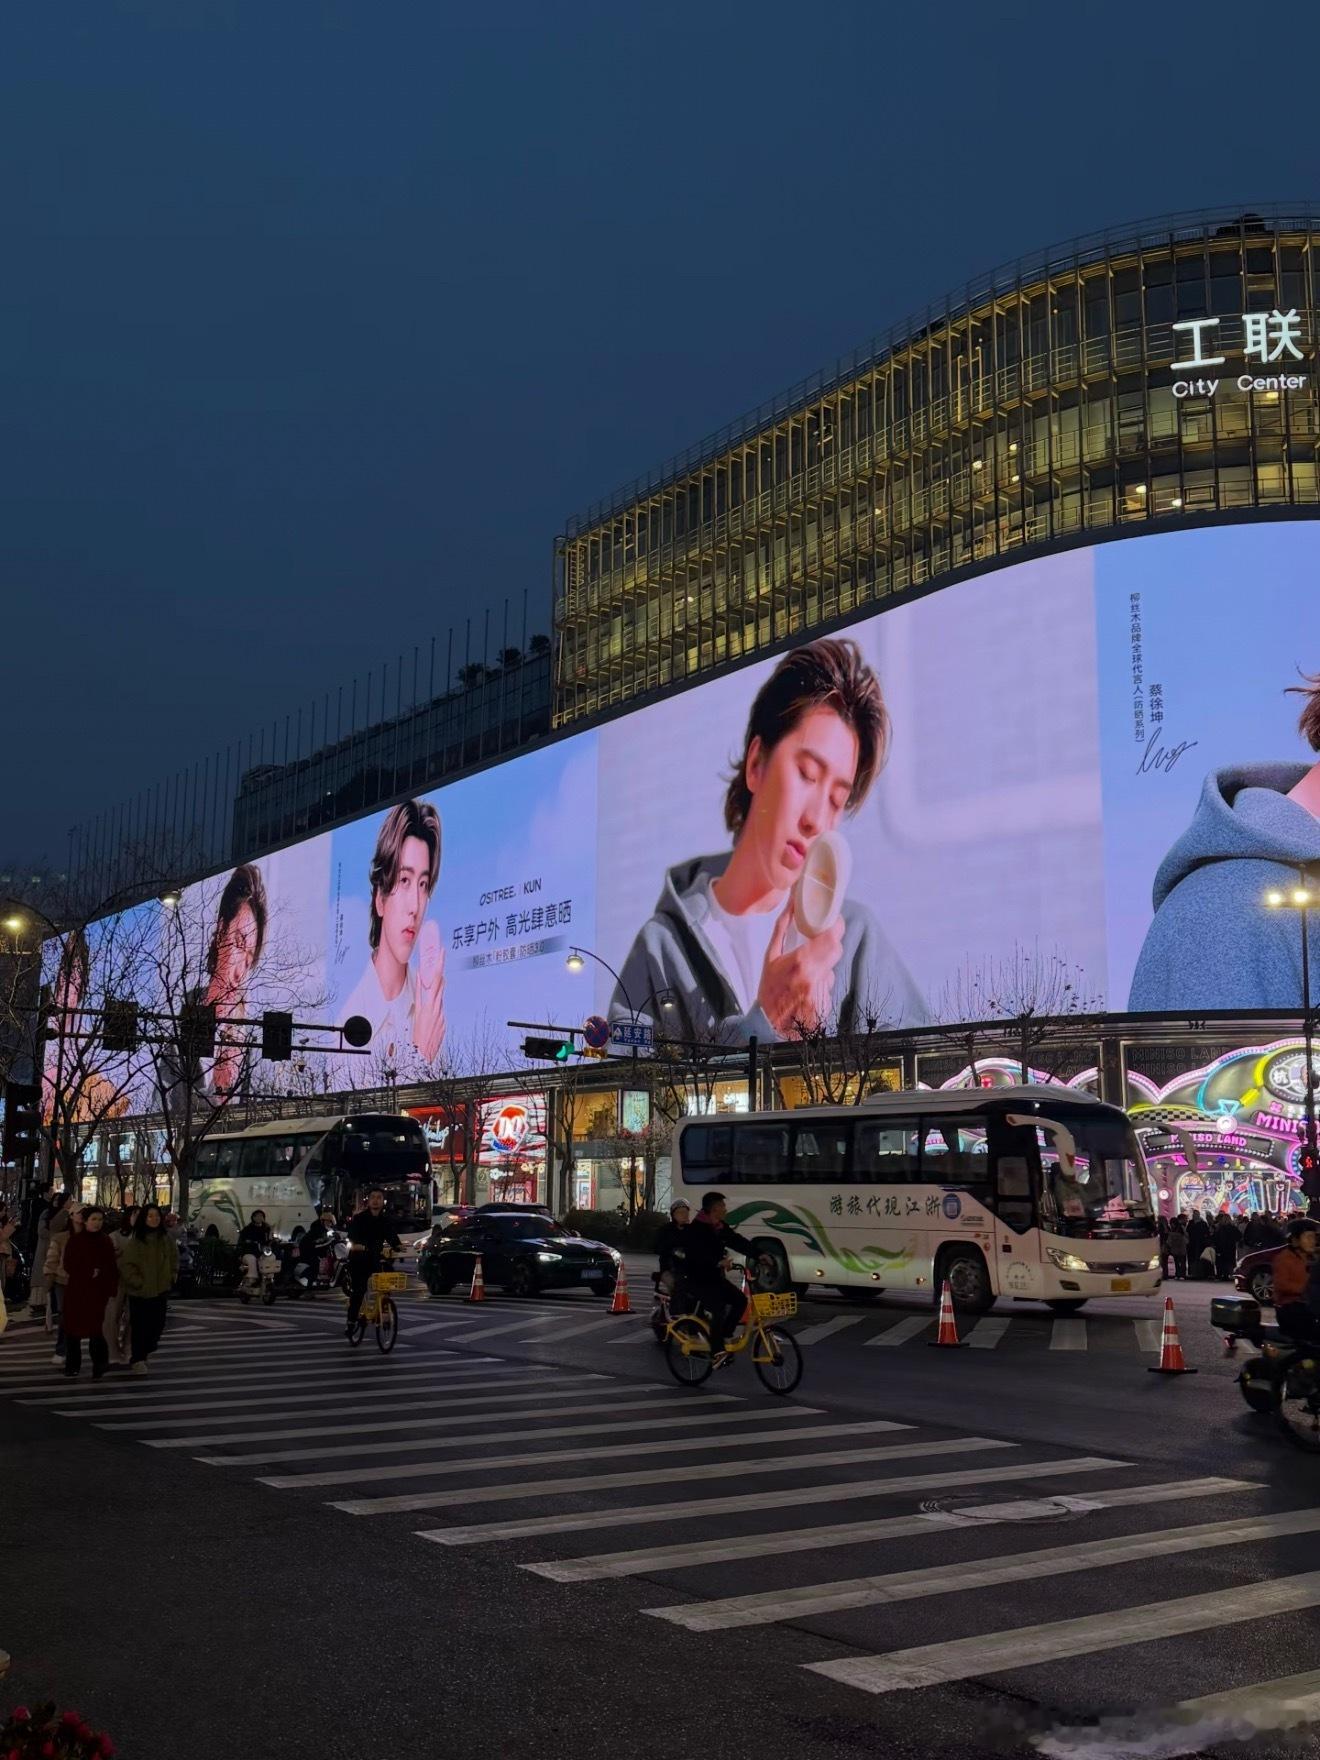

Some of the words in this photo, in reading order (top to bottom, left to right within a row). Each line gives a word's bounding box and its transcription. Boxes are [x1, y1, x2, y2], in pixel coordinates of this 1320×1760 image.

[1170, 308, 1304, 371] 工联
[1172, 378, 1219, 398] City
[1237, 373, 1307, 392] Center
[1149, 684, 1164, 722] 蔡徐坤
[523, 877, 542, 895] KUN
[451, 917, 500, 951] 乐享户外
[505, 899, 572, 939] 高光肆意晒
[1217, 1134, 1247, 1147] LAND
